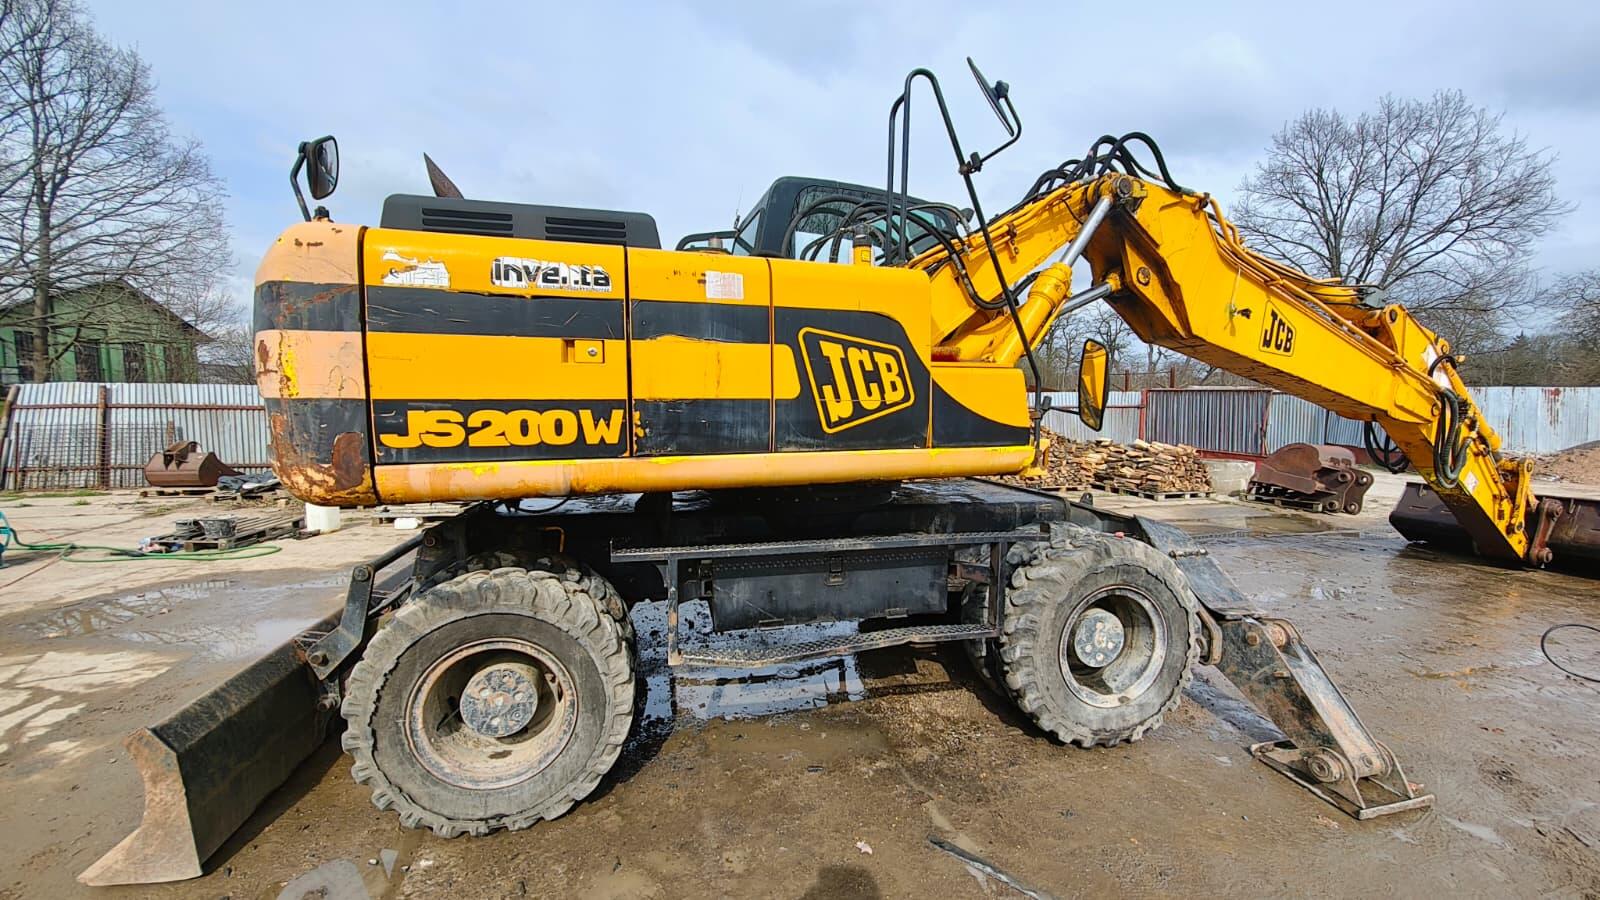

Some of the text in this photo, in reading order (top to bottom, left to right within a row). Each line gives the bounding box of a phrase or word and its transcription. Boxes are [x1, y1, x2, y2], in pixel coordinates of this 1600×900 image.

[1262, 308, 1294, 353] JCB
[819, 340, 905, 423] JCB
[379, 409, 624, 448] JS200W
